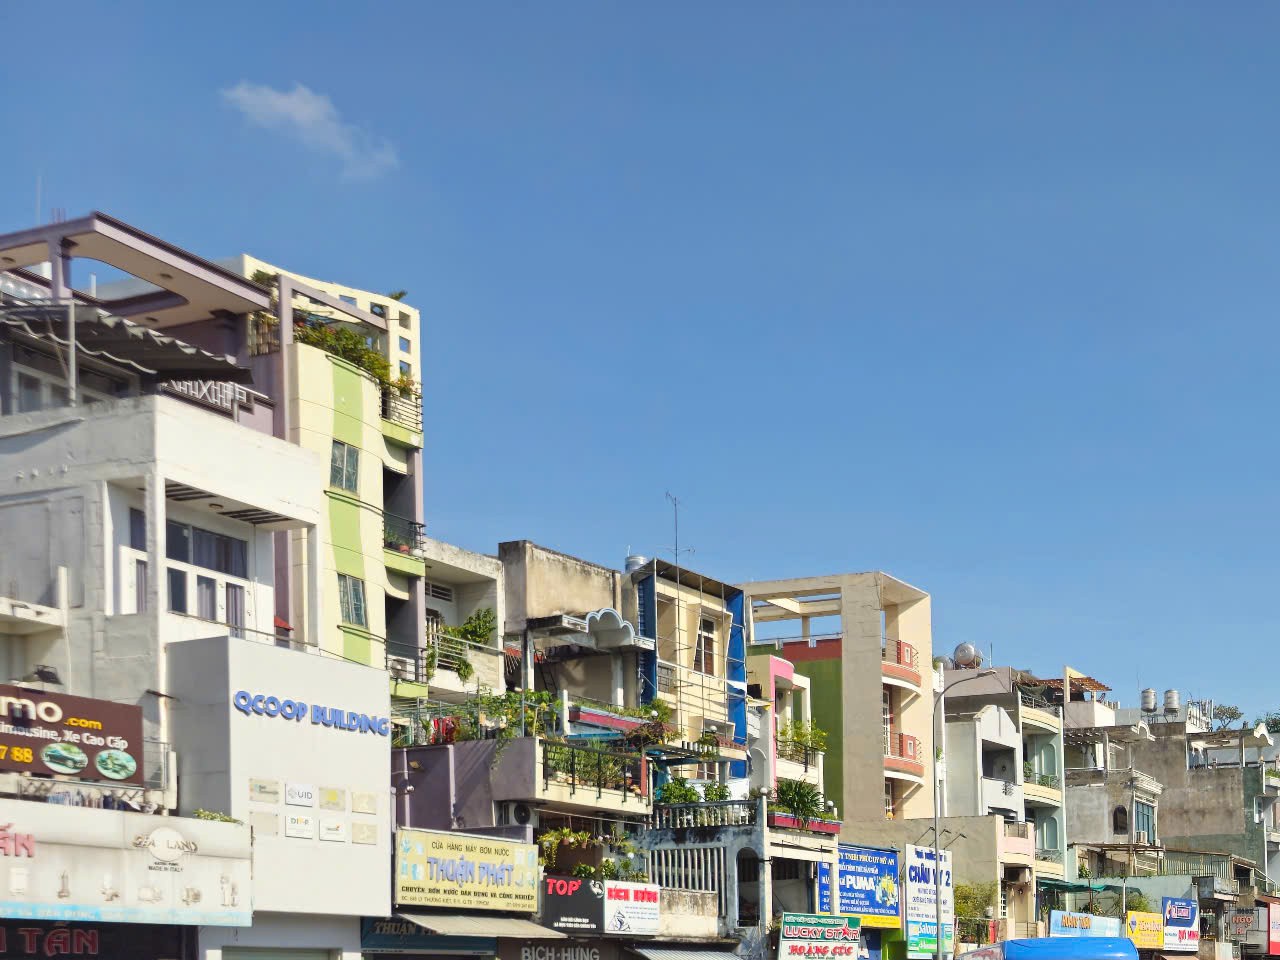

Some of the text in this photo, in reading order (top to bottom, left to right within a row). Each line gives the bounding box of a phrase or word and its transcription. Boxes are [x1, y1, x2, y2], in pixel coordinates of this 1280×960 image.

[234, 690, 390, 737] QCOOP BUILDING
[64, 717, 102, 730] .com
[63, 729, 80, 743] Xe
[82, 732, 105, 747] Cao
[10, 746, 34, 763] 88
[427, 855, 514, 889] THUẬN PHÁT
[909, 863, 931, 884] CHÂU
[945, 870, 951, 887] 2
[785, 926, 823, 938] LUCKY
